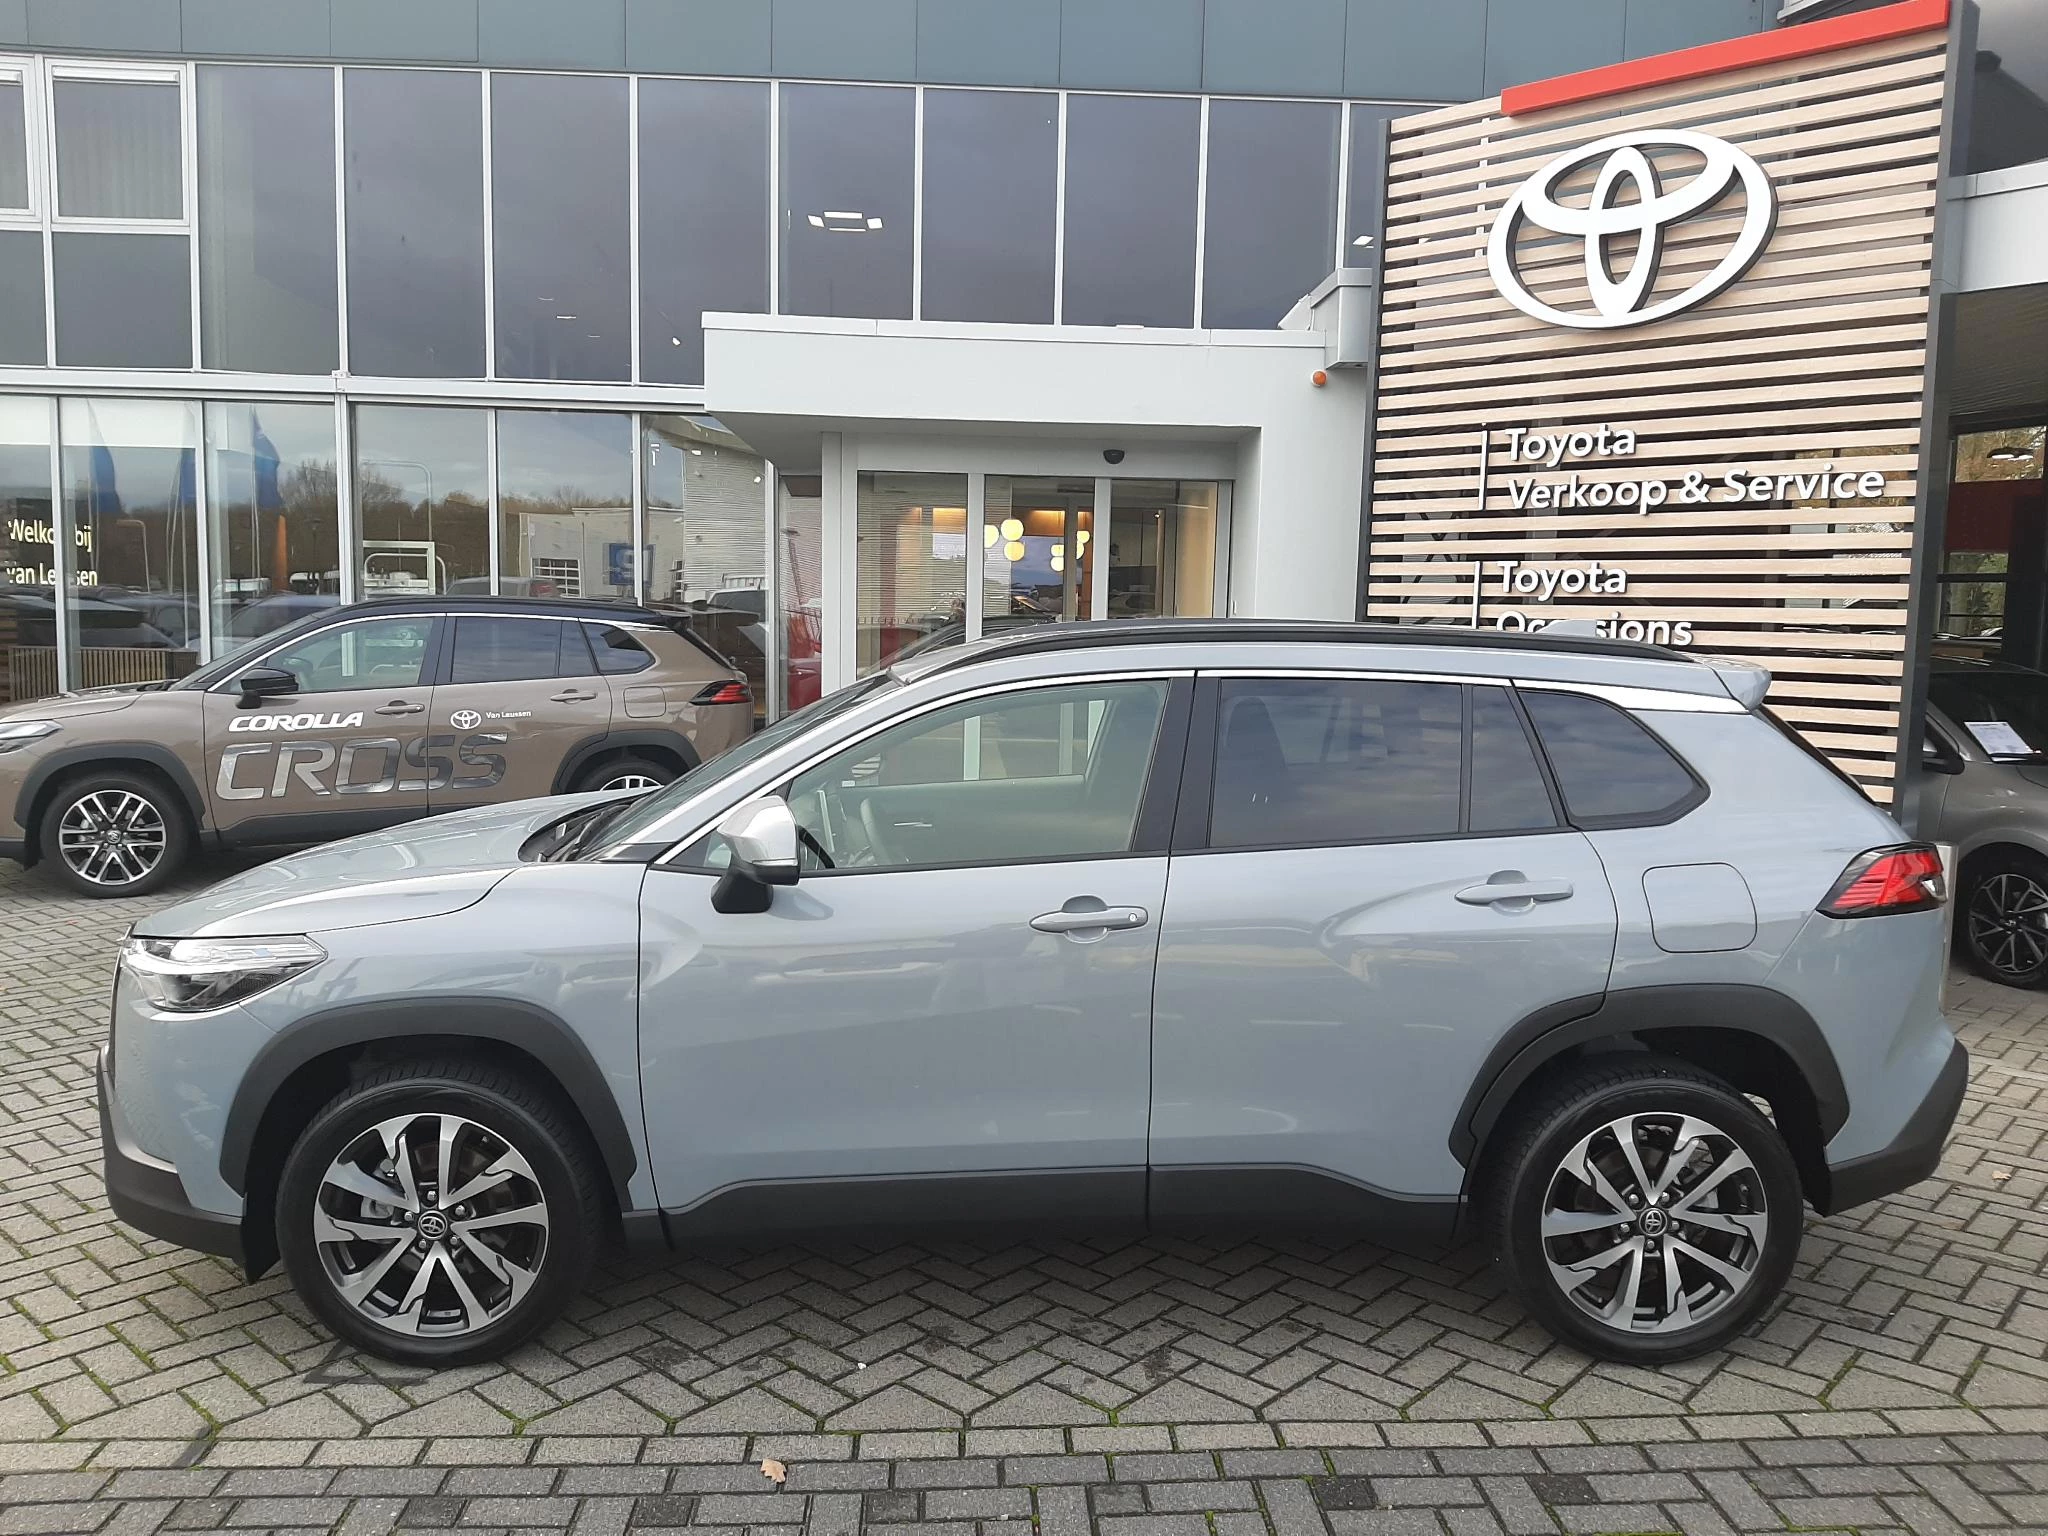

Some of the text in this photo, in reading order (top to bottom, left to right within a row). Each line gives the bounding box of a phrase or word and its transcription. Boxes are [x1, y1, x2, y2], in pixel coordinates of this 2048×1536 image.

[1505, 424, 1636, 468] Toyota
[1507, 462, 1885, 515] Verkoop & Service
[75, 523, 92, 552] bij
[6, 566, 35, 584] van
[1497, 560, 1627, 602] Toyota
[228, 711, 364, 732] COROLLA
[485, 711, 501, 719] Van
[215, 732, 508, 800] CROSS
